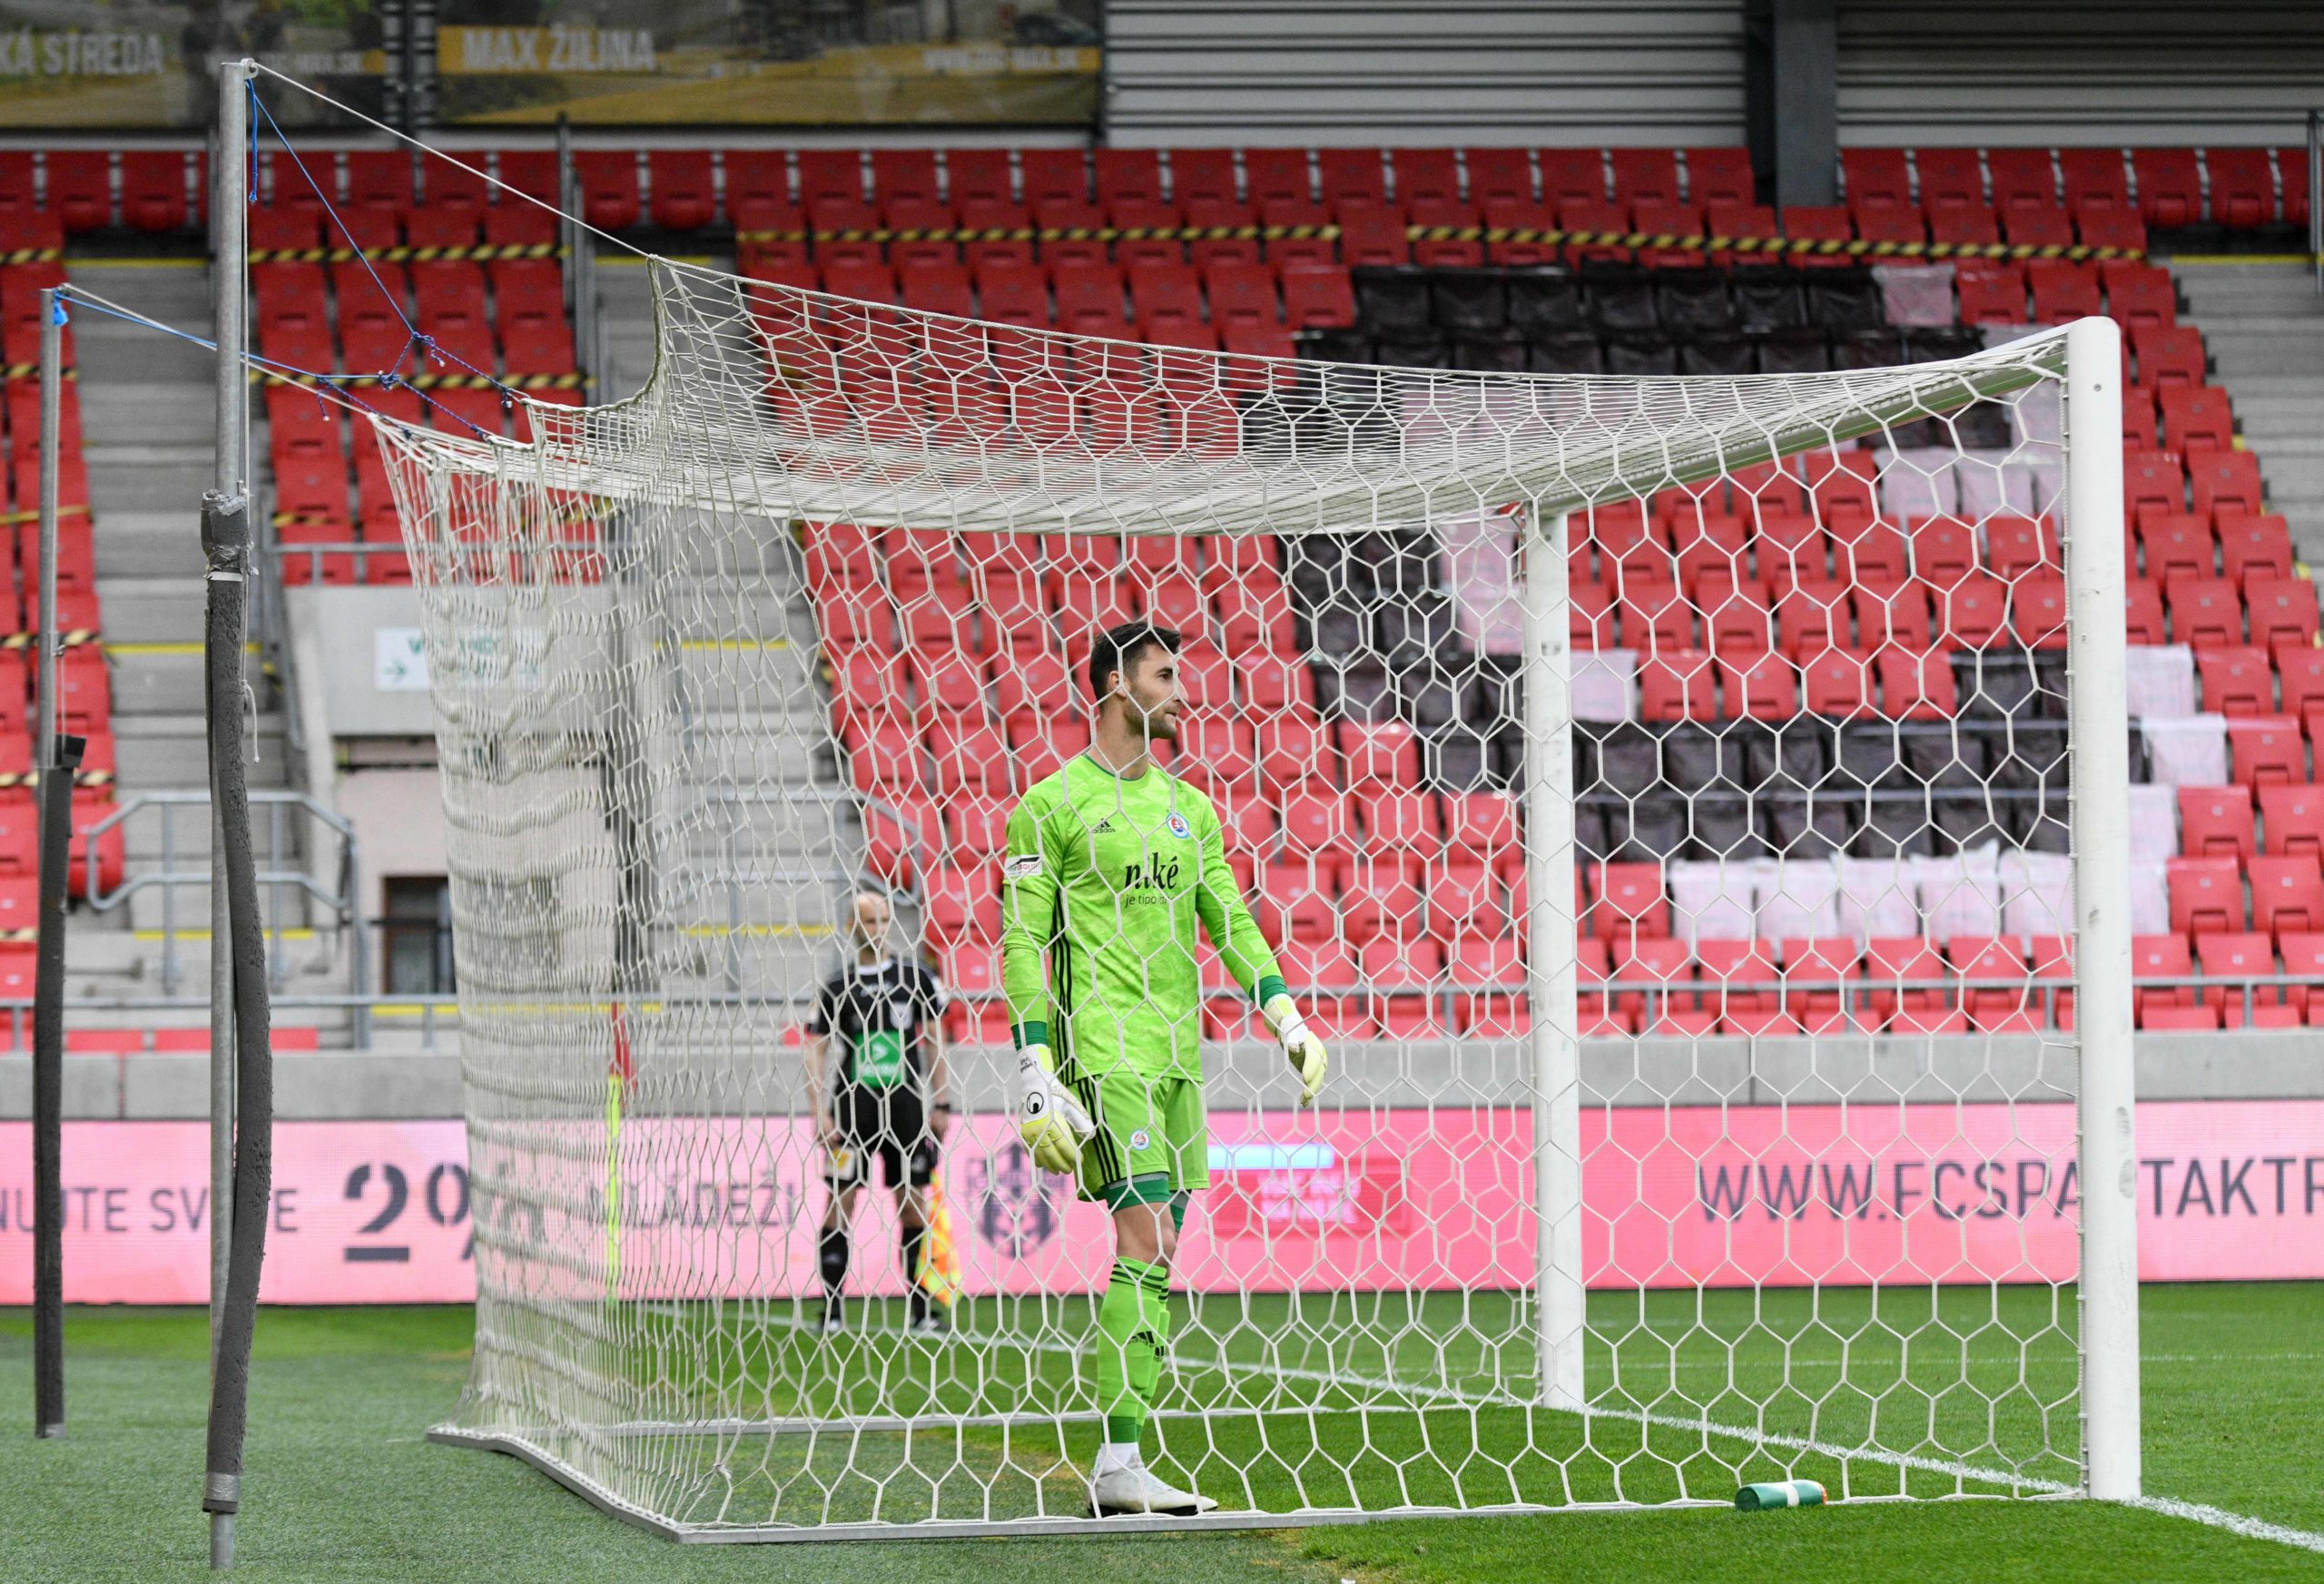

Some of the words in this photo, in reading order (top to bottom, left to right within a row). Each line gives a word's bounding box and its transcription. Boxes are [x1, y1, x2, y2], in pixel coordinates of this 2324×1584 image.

[464, 28, 540, 71] MAX
[548, 22, 656, 71] ŽILINA
[1125, 895, 1136, 908] je
[150, 1187, 298, 1233] SVE
[1697, 1157, 2324, 1222] WWW.FCSPATAKTR
